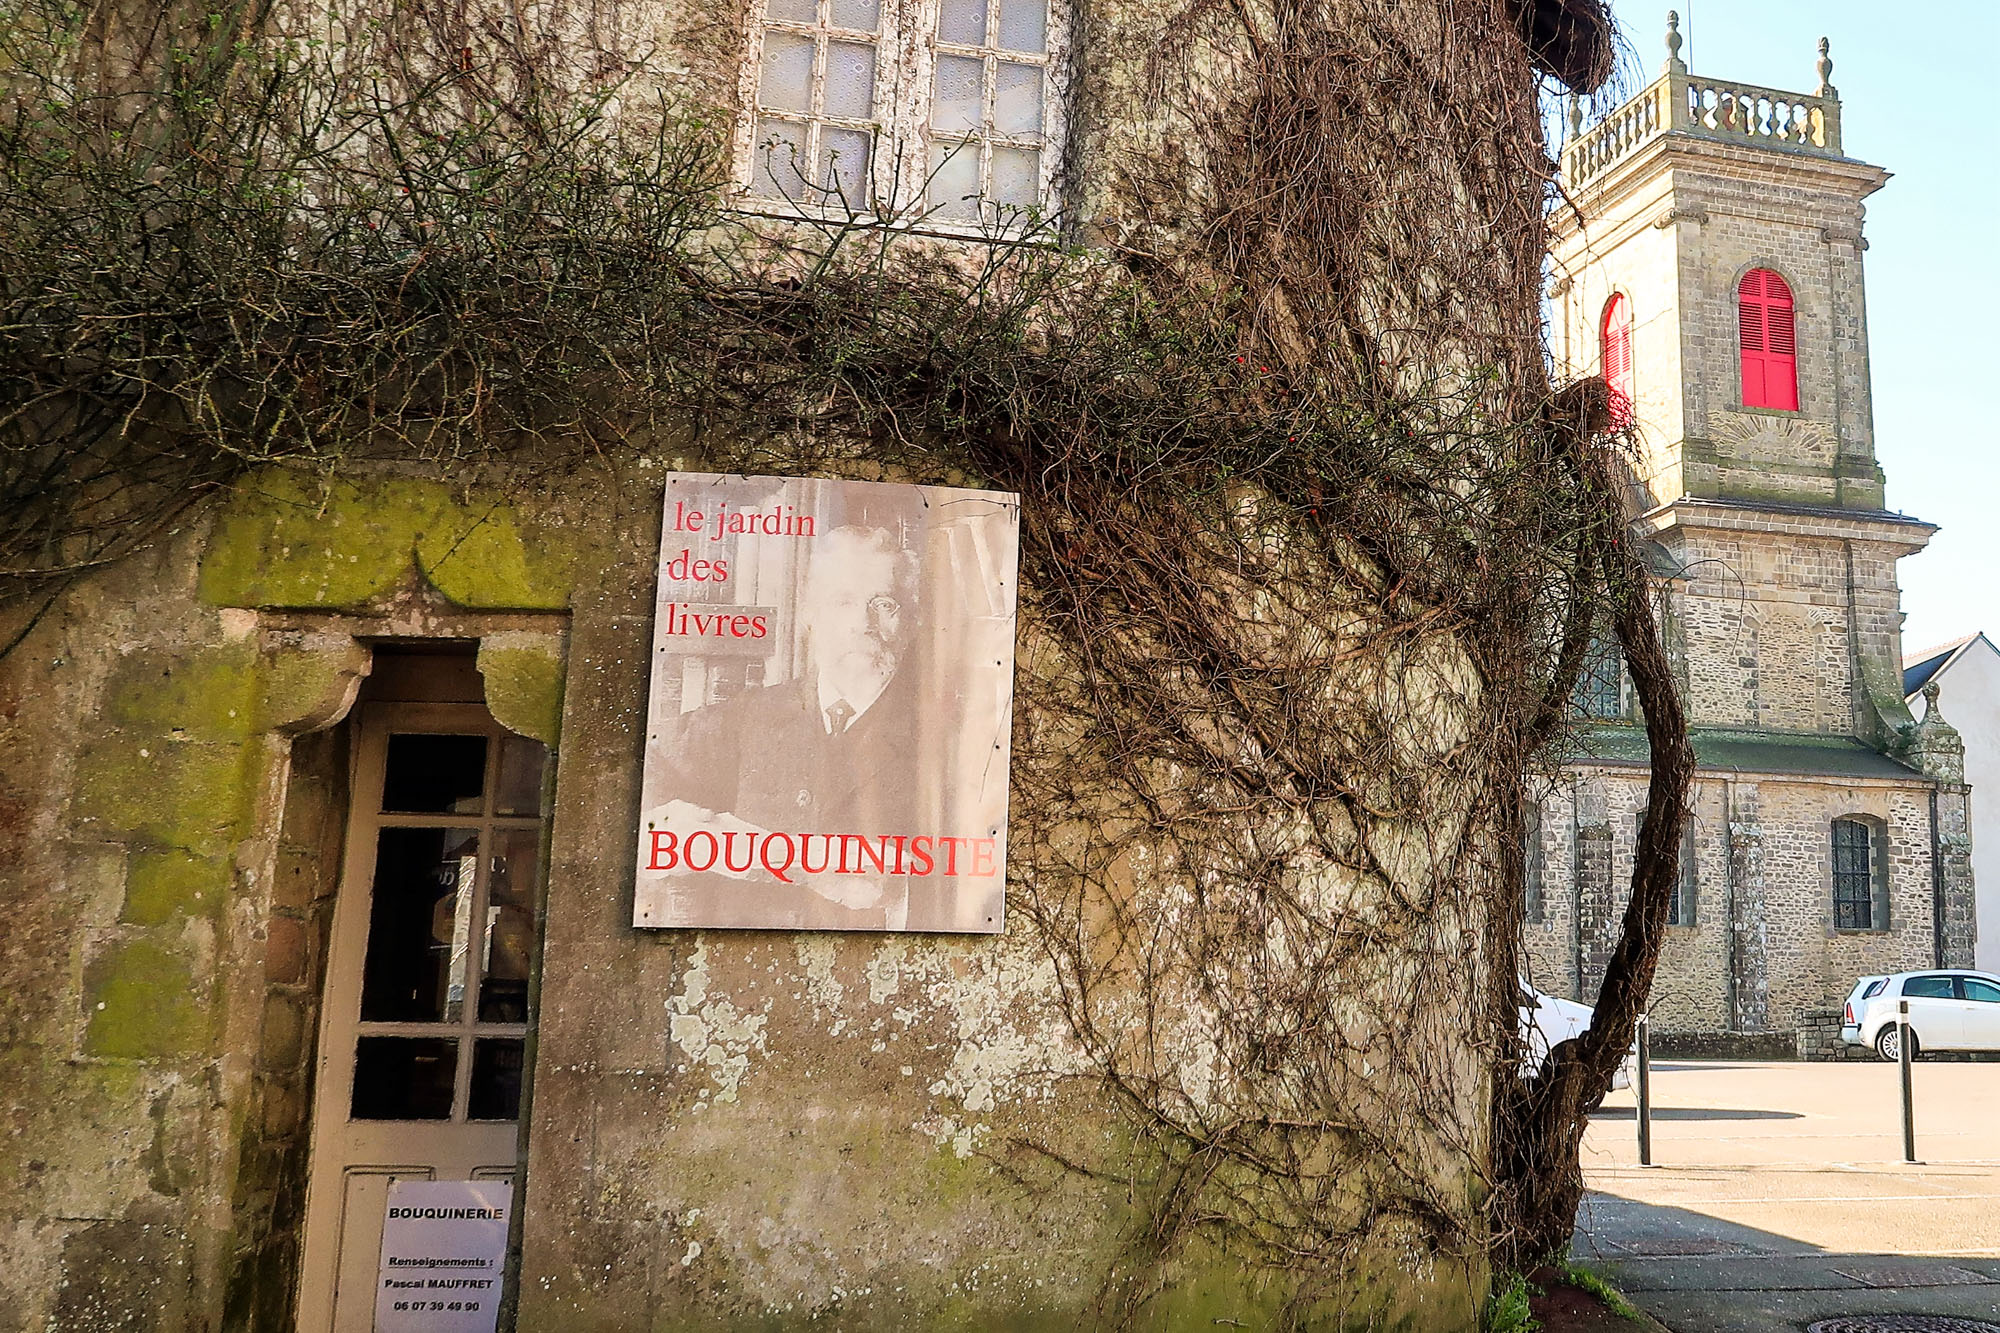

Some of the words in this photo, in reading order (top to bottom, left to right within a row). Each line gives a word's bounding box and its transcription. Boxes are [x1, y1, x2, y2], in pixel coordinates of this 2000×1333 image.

[673, 501, 704, 532] le
[710, 503, 816, 541] jardin
[668, 549, 728, 582] des
[665, 603, 767, 638] livres
[645, 829, 997, 883] BOUQUINISTE
[389, 1208, 503, 1220] BOUQUINERIE
[389, 1257, 486, 1268] Renseignements
[385, 1279, 424, 1288] Pascal
[428, 1280, 494, 1289] MAUFFRET
[394, 1302, 408, 1310] 06
[412, 1302, 426, 1310] 07
[429, 1302, 444, 1310] 39
[465, 1302, 480, 1311] 90
